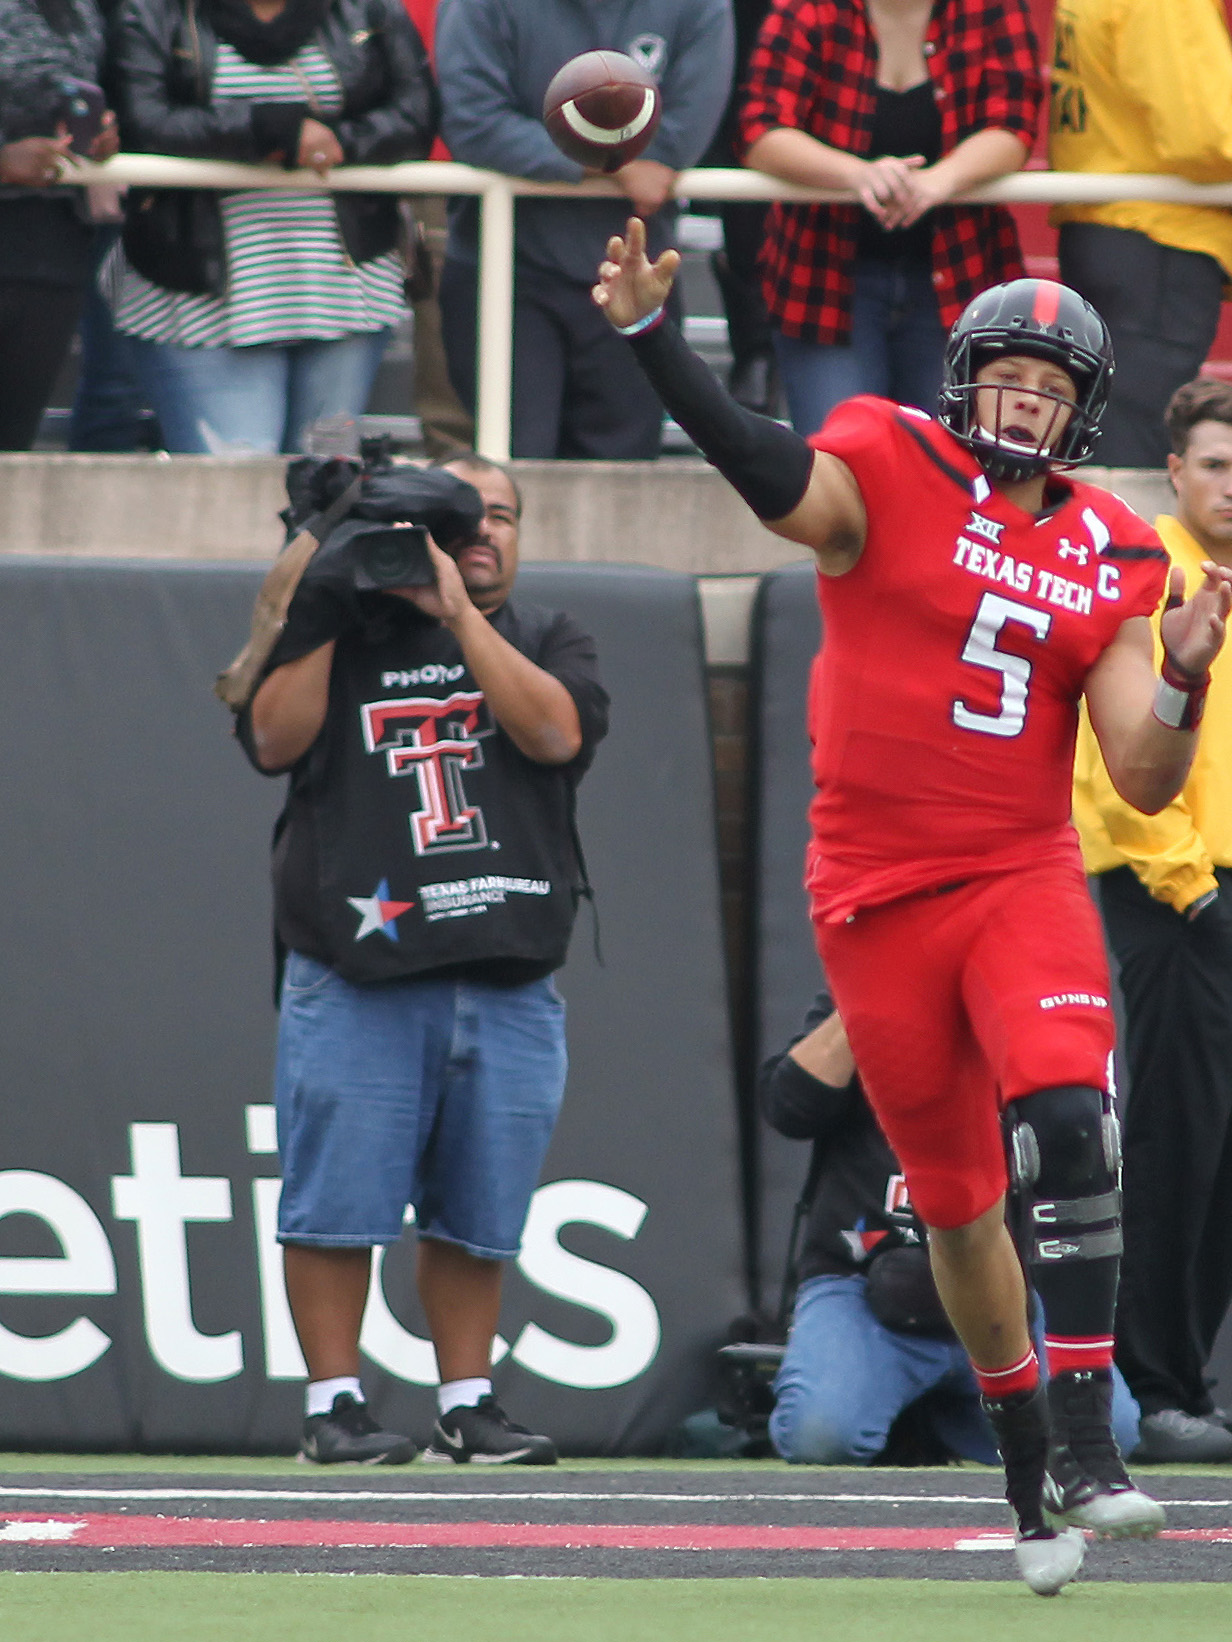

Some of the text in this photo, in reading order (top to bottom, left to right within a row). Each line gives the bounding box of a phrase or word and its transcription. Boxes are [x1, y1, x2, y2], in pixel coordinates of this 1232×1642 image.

[952, 536, 1093, 616] TEXAS TECH
[1097, 563, 1121, 601] C
[952, 590, 1053, 737] 5
